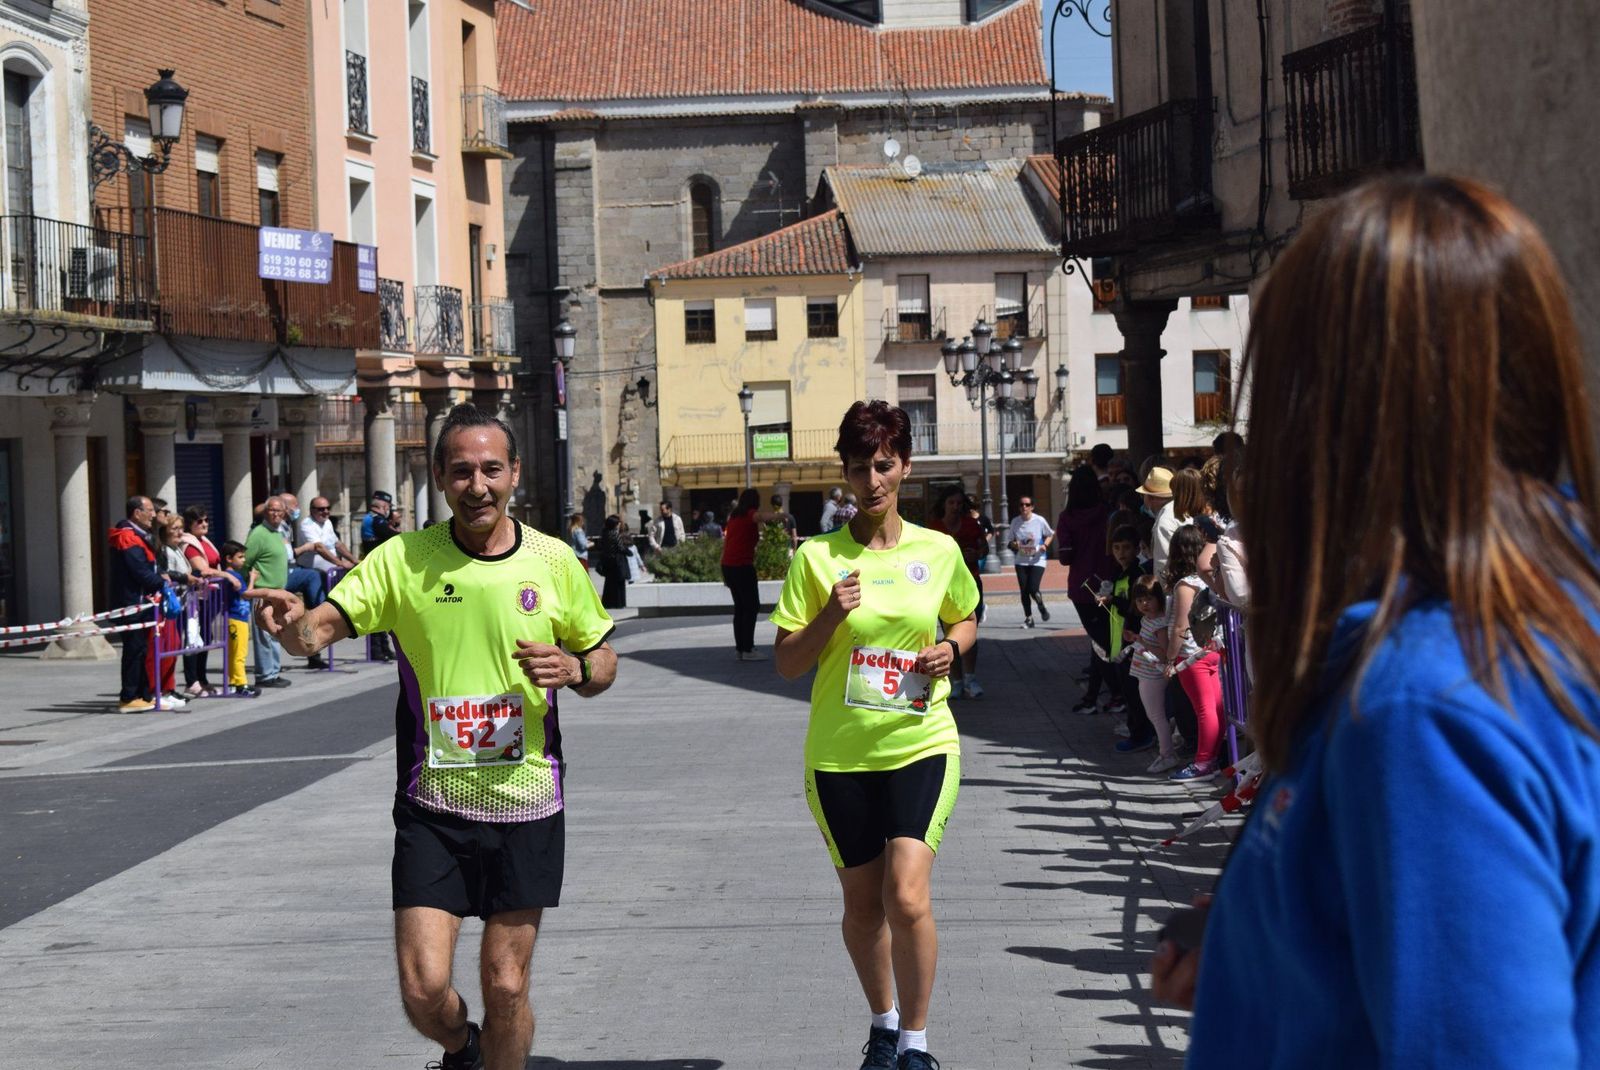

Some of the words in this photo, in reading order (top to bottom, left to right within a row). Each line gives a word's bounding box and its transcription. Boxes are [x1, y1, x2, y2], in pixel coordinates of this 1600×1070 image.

[263, 231, 302, 251] VENDE
[263, 254, 281, 265] 619
[284, 256, 296, 267] 30
[298, 257, 312, 268] 60
[314, 259, 327, 269] 50
[263, 265, 281, 276] 923
[283, 267, 297, 278] 26
[298, 268, 312, 279] 68
[314, 270, 327, 280] 34
[883, 670, 900, 695] 5
[457, 721, 496, 749] 52
